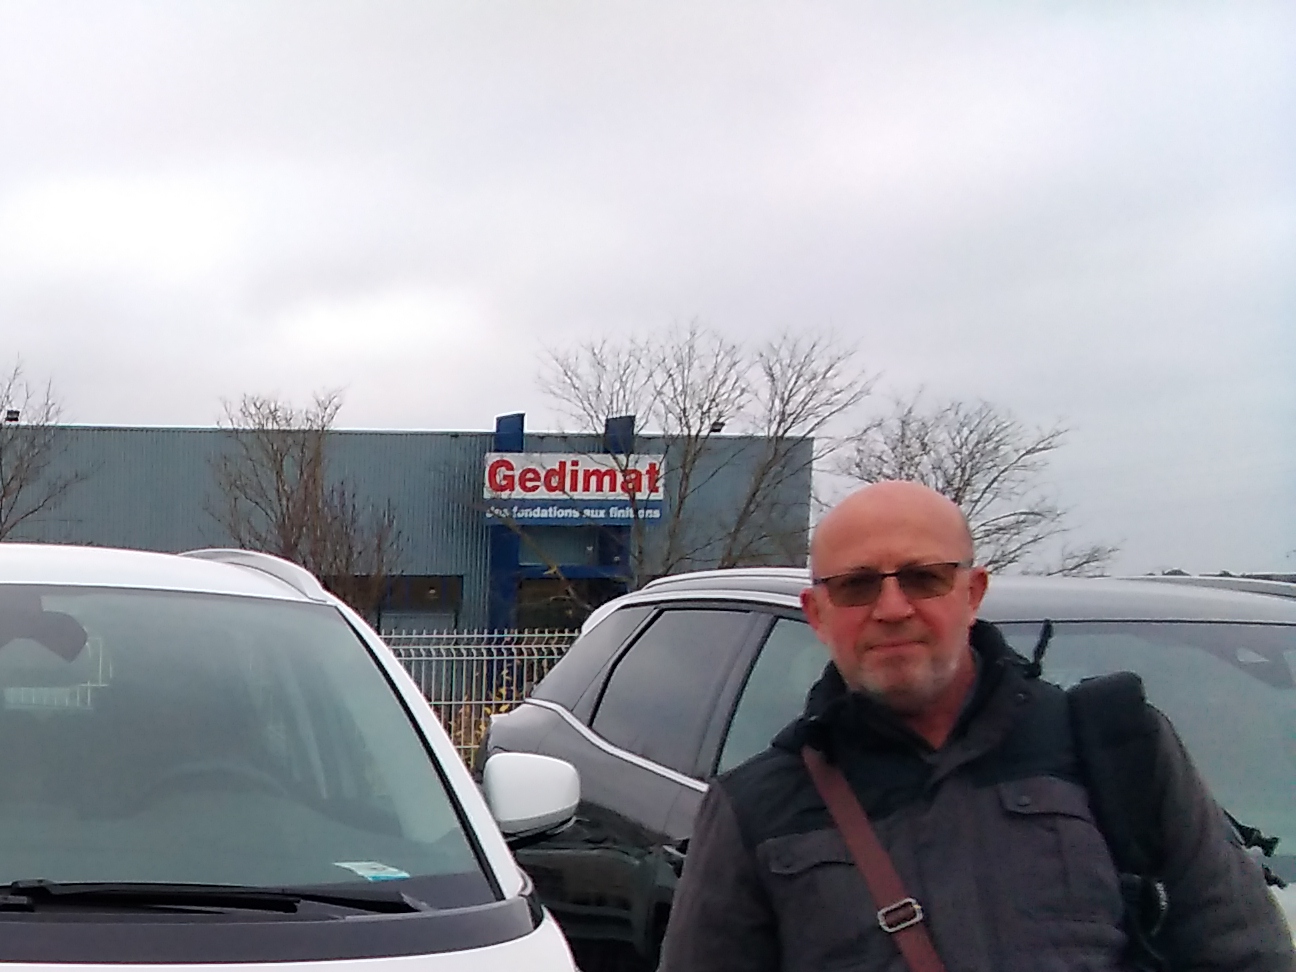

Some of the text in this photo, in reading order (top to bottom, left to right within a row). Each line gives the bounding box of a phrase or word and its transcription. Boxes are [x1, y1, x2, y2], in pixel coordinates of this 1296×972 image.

[487, 458, 661, 495] Gedimat
[512, 505, 579, 519] fondations
[582, 508, 606, 519] aux
[609, 506, 661, 519] finitons
